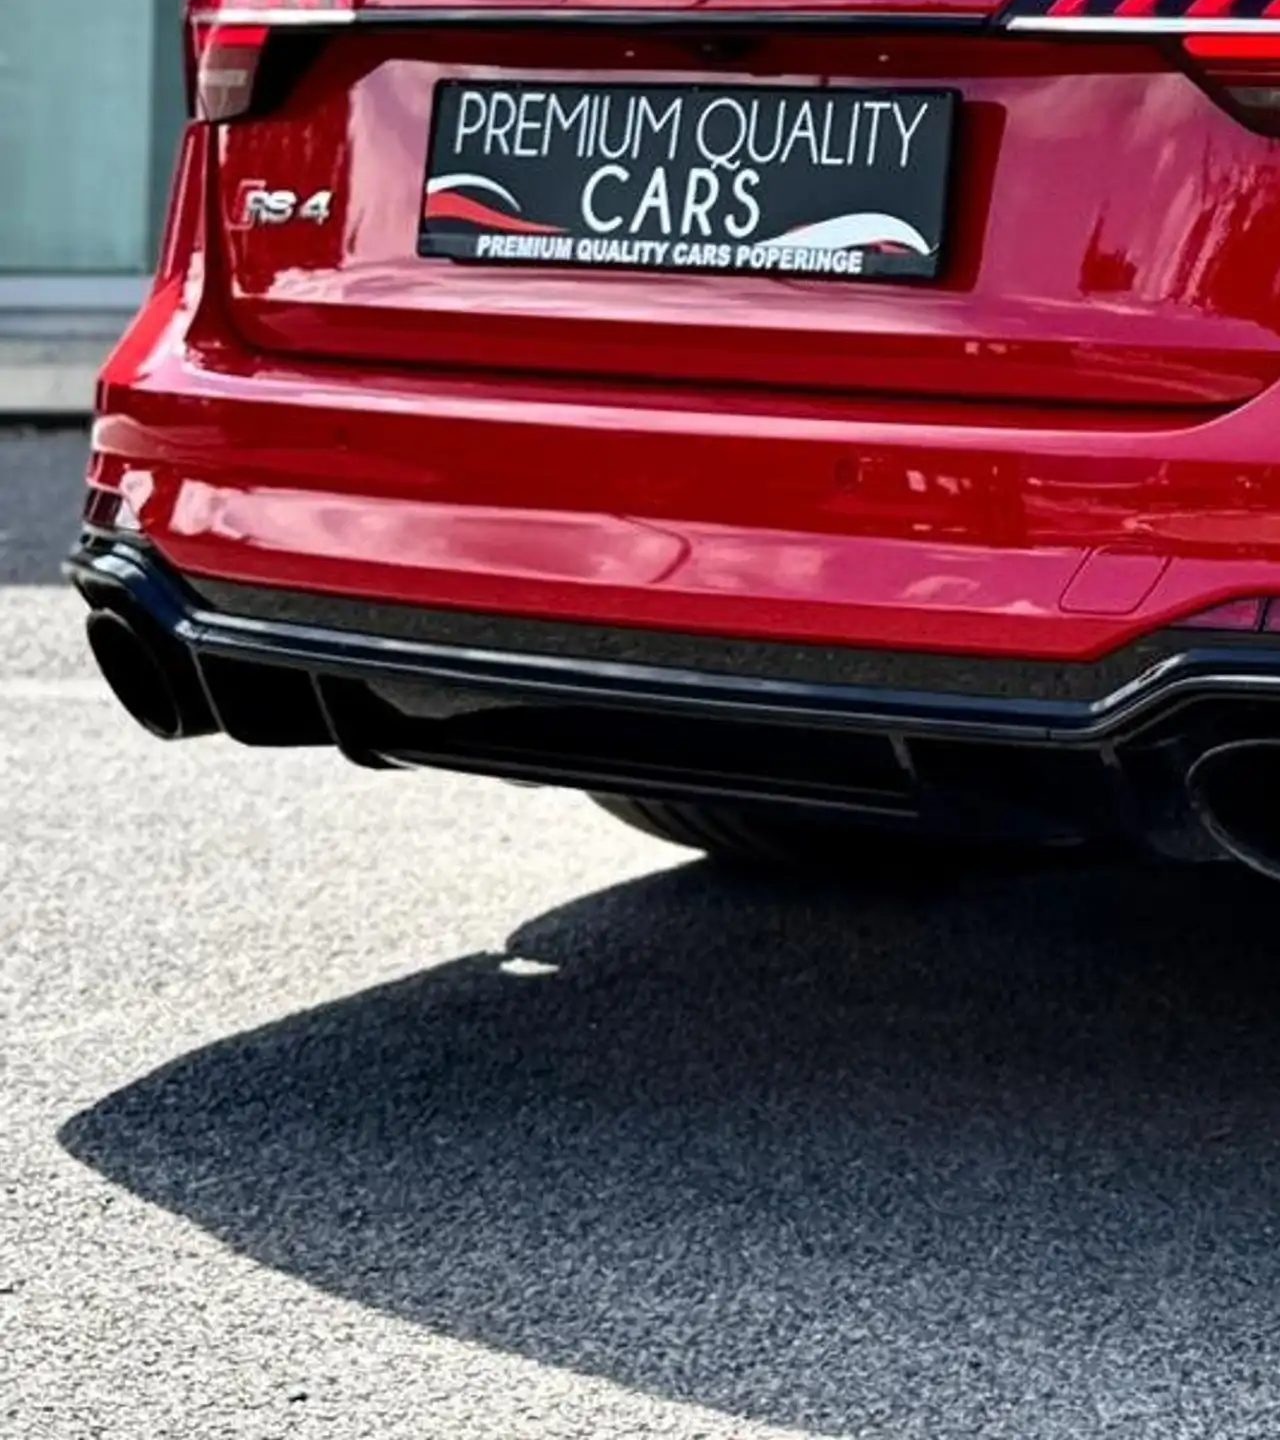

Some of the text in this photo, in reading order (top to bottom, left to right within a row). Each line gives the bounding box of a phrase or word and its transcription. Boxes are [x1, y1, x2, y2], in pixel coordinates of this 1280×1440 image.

[454, 91, 928, 170] PREMIUM QUALITY
[581, 165, 761, 238] CARS
[476, 234, 863, 274] PREMIUM QUALITY CARS POPERINGE
